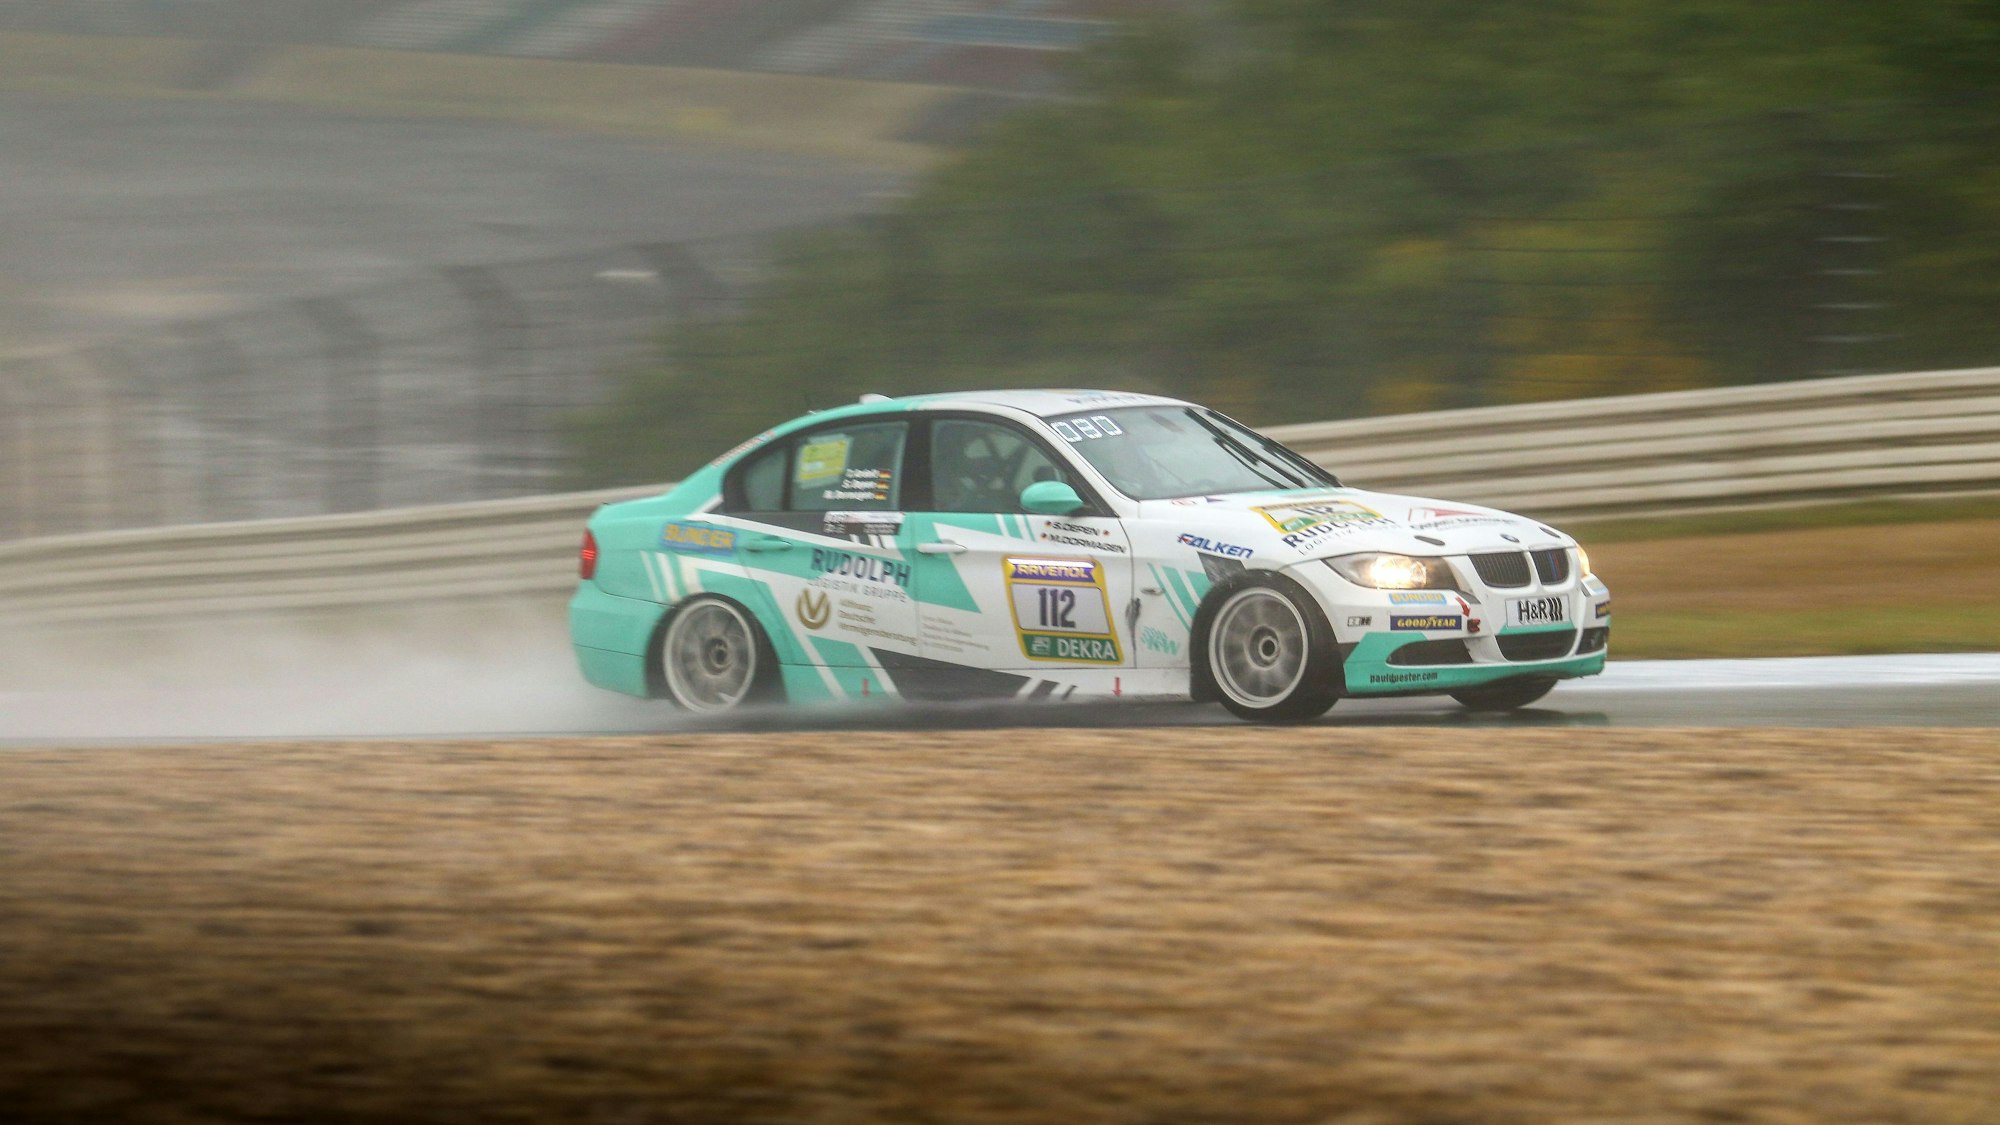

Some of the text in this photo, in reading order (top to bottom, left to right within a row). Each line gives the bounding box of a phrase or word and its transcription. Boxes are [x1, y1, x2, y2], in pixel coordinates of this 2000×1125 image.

[1177, 532, 1254, 559] FALKEN
[811, 548, 911, 587] RUDOLPH
[1017, 564, 1089, 578] RAVENOL
[1038, 587, 1076, 628] 112
[1397, 615, 1457, 628] GOODYEAR
[1057, 638, 1117, 660] DEKRA
